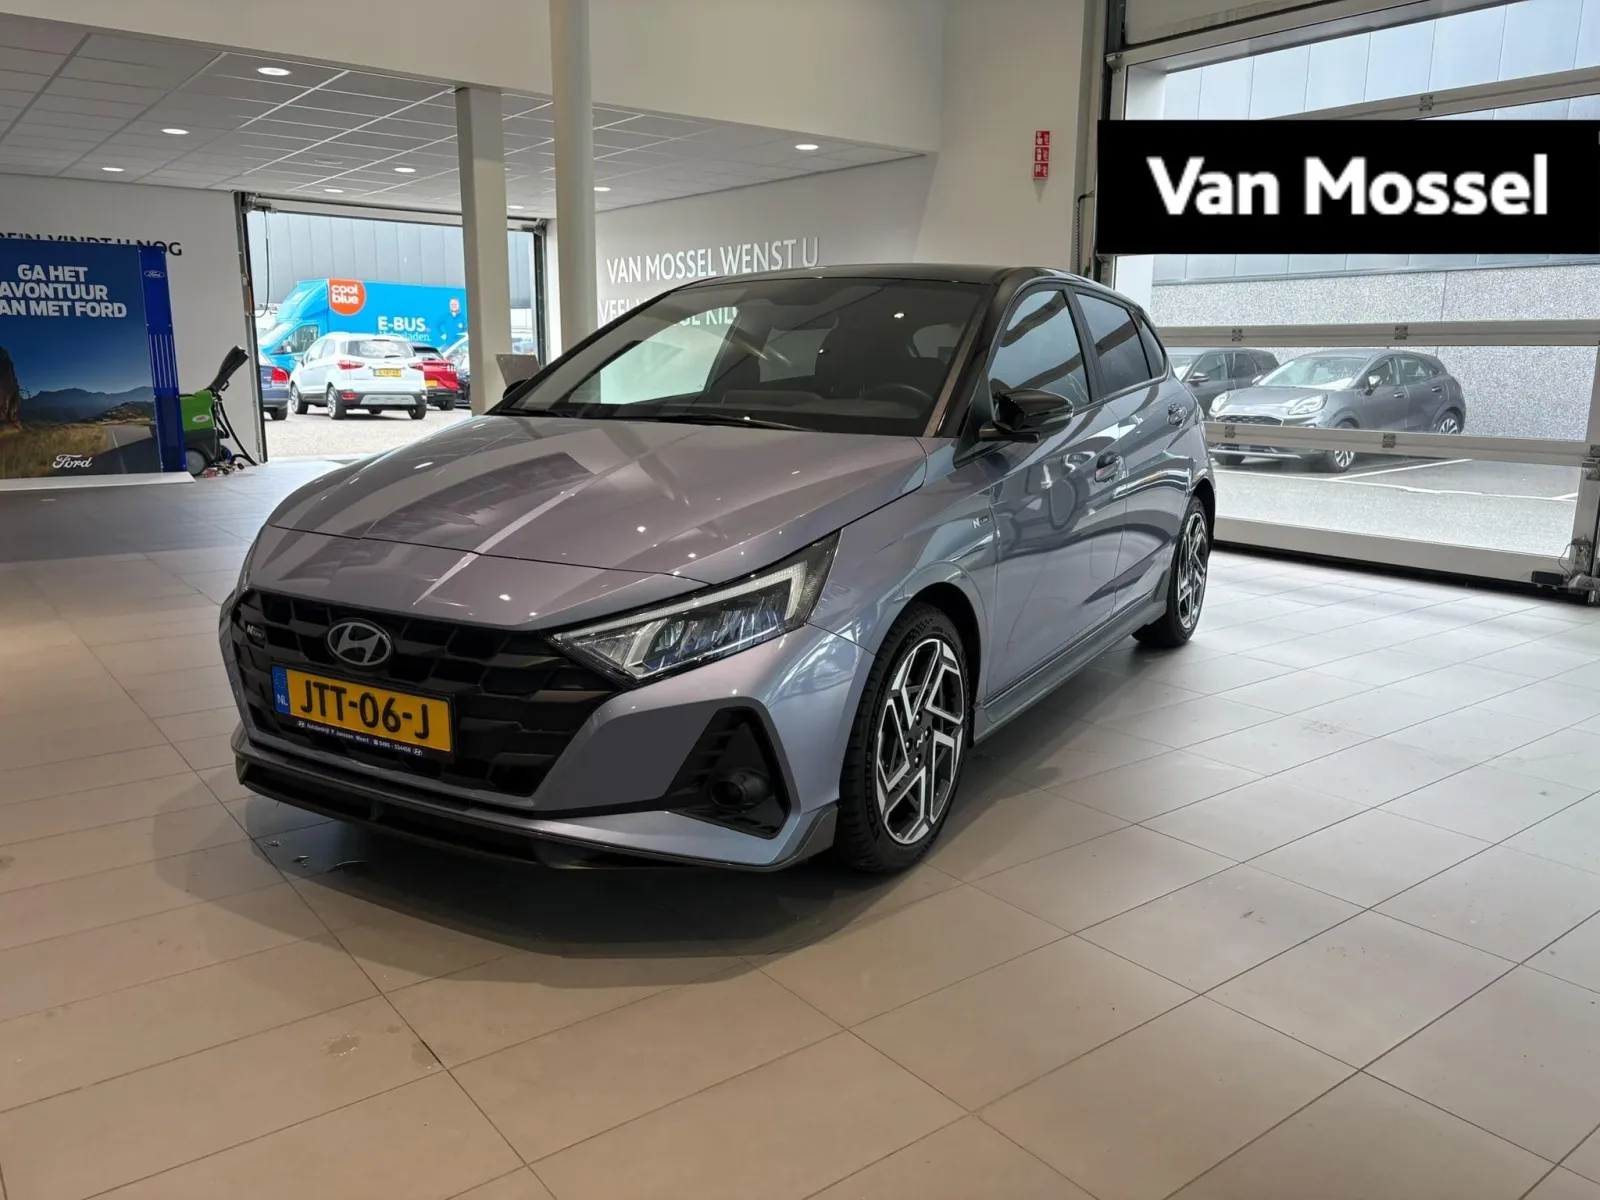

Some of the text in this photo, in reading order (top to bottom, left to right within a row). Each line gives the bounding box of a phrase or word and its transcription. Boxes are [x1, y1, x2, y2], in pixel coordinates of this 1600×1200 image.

[606, 237, 820, 285] VAN MOSSEL WENST U
[17, 263, 88, 282] GA HET
[0, 281, 108, 300] AVONTUUR
[331, 284, 358, 295] cool
[332, 293, 358, 304] blue
[30, 301, 72, 317] MET
[75, 302, 127, 318] FORD
[52, 454, 92, 469] Ford
[277, 694, 289, 706] NL
[300, 680, 430, 740] JTT-06-J
